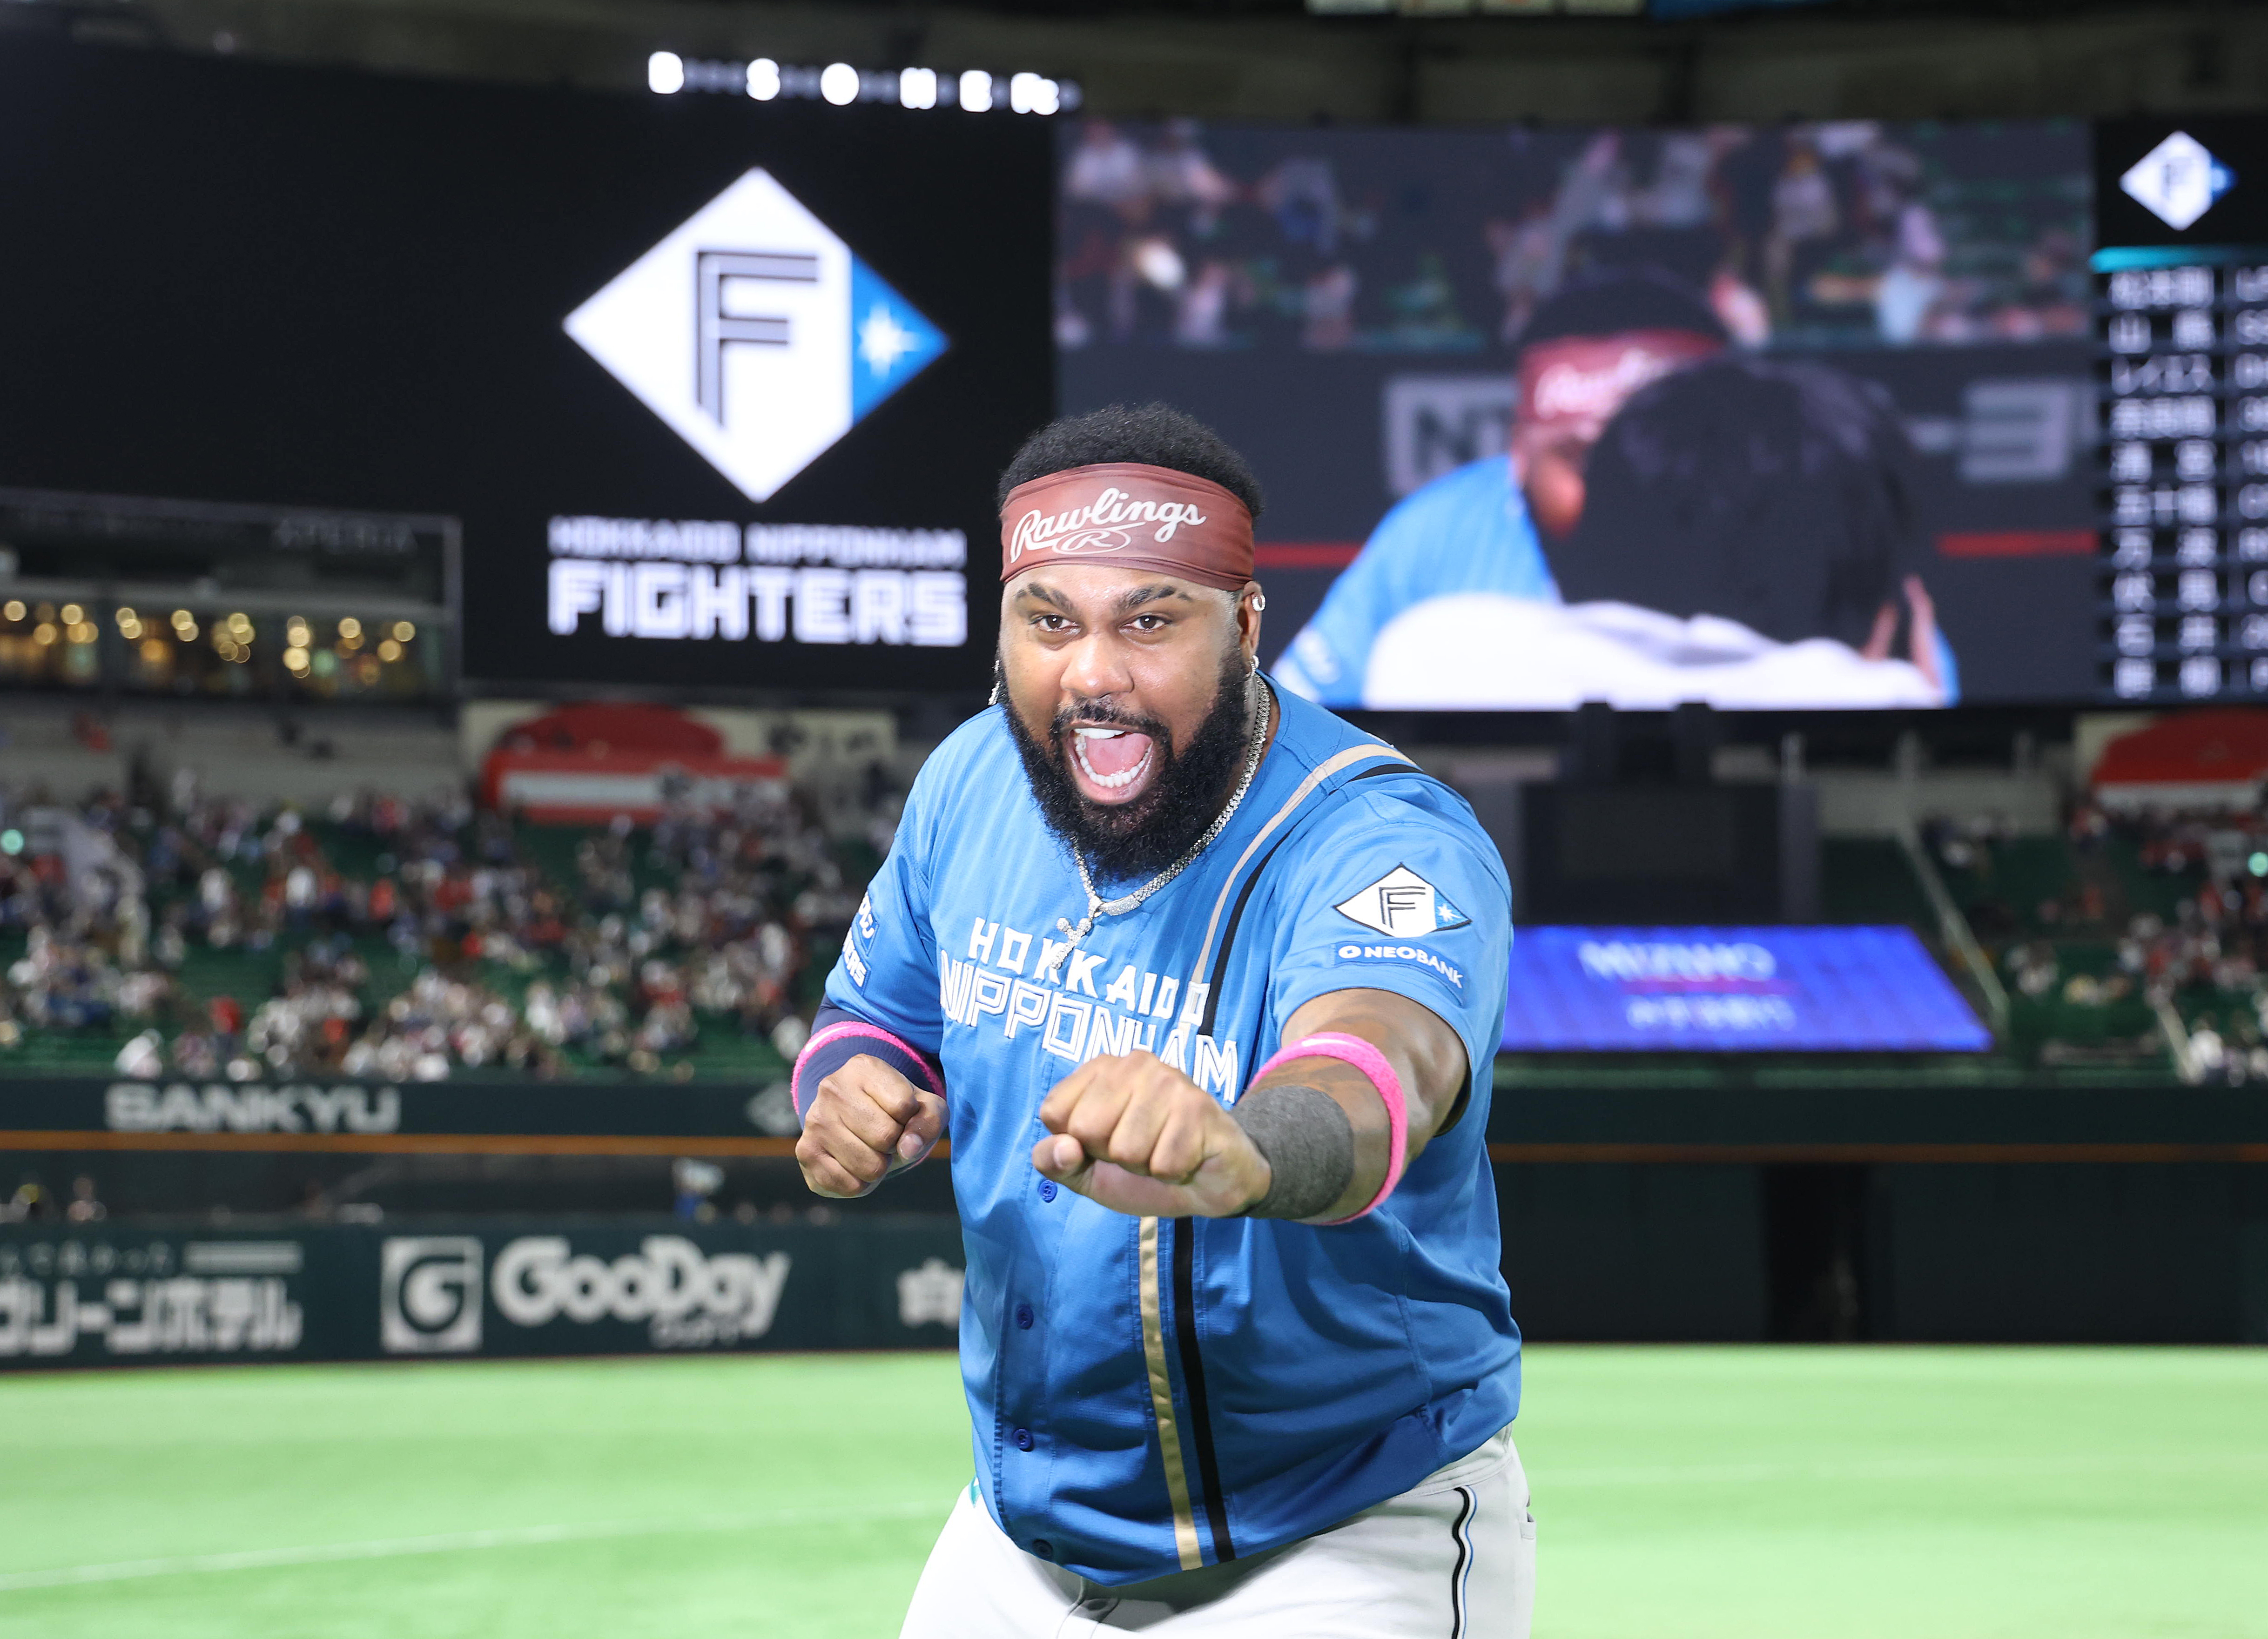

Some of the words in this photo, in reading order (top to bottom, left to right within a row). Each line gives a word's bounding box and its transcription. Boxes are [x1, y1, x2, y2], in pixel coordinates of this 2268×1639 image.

[697, 249, 818, 430] F
[551, 518, 738, 559] HOKKAIDO
[748, 525, 964, 566] NIPPONHAM
[1009, 487, 1207, 563] Rawlings
[551, 561, 964, 644] FIGHTERS
[1379, 886, 1426, 930] F
[968, 917, 1211, 1026] HOKKAIDO
[1364, 946, 1464, 988] NEOBANK
[940, 949, 1239, 1103] NIPPONHAM
[107, 1085, 399, 1132] SANKYU
[493, 1238, 789, 1337] GooDay
